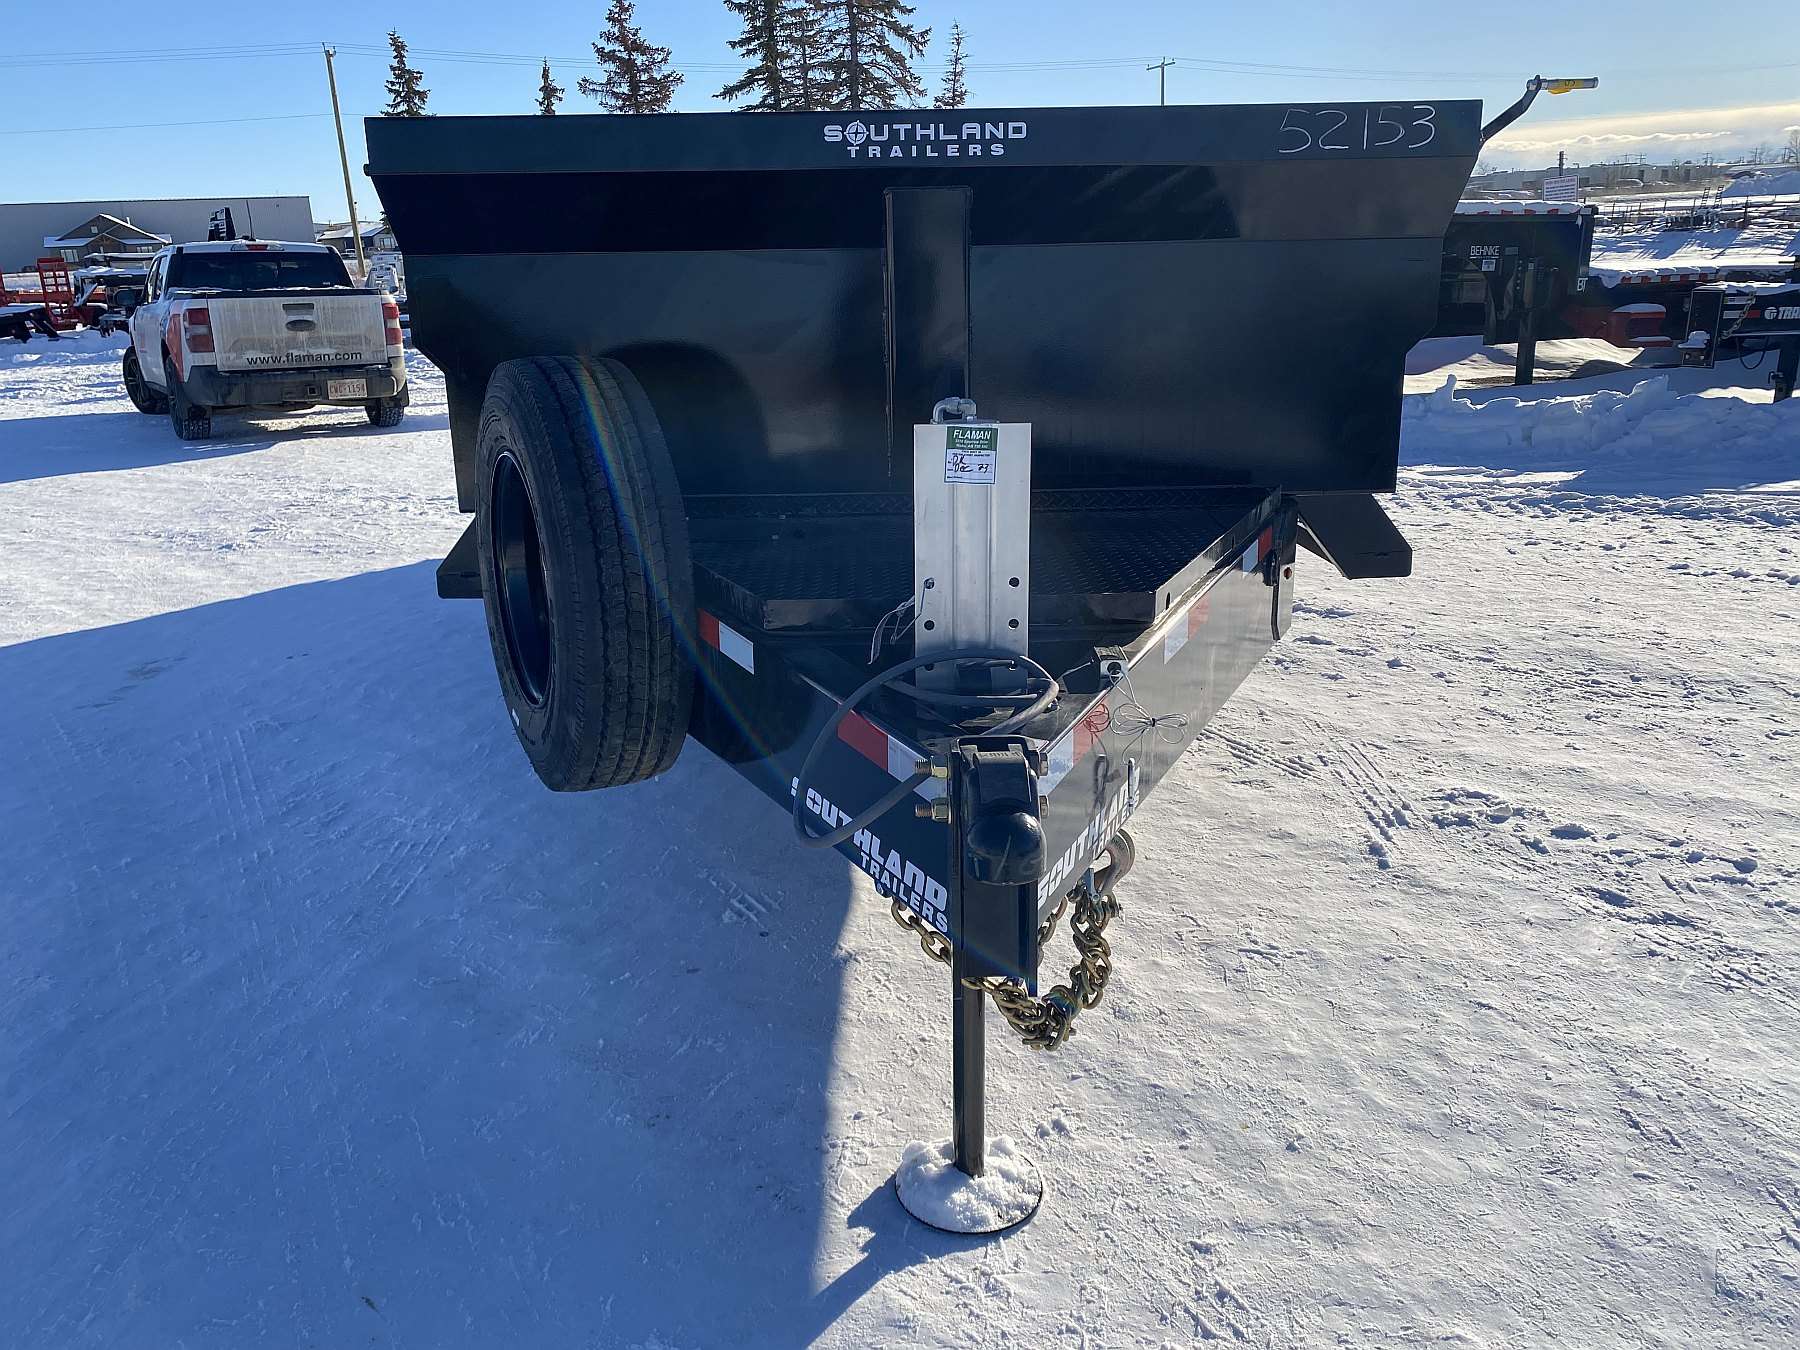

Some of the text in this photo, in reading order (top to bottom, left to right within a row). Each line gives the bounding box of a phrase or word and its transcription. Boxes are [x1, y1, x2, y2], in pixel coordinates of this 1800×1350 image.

[823, 120, 1027, 145] SOUTHLAND
[1278, 105, 1436, 153] 52153
[847, 144, 1005, 158] TRAILERS
[1470, 246, 1500, 256] BEHNKE
[246, 352, 362, 365] www.flaman.com
[953, 430, 991, 440] FLAMAN
[860, 851, 949, 933] TRAILERS
